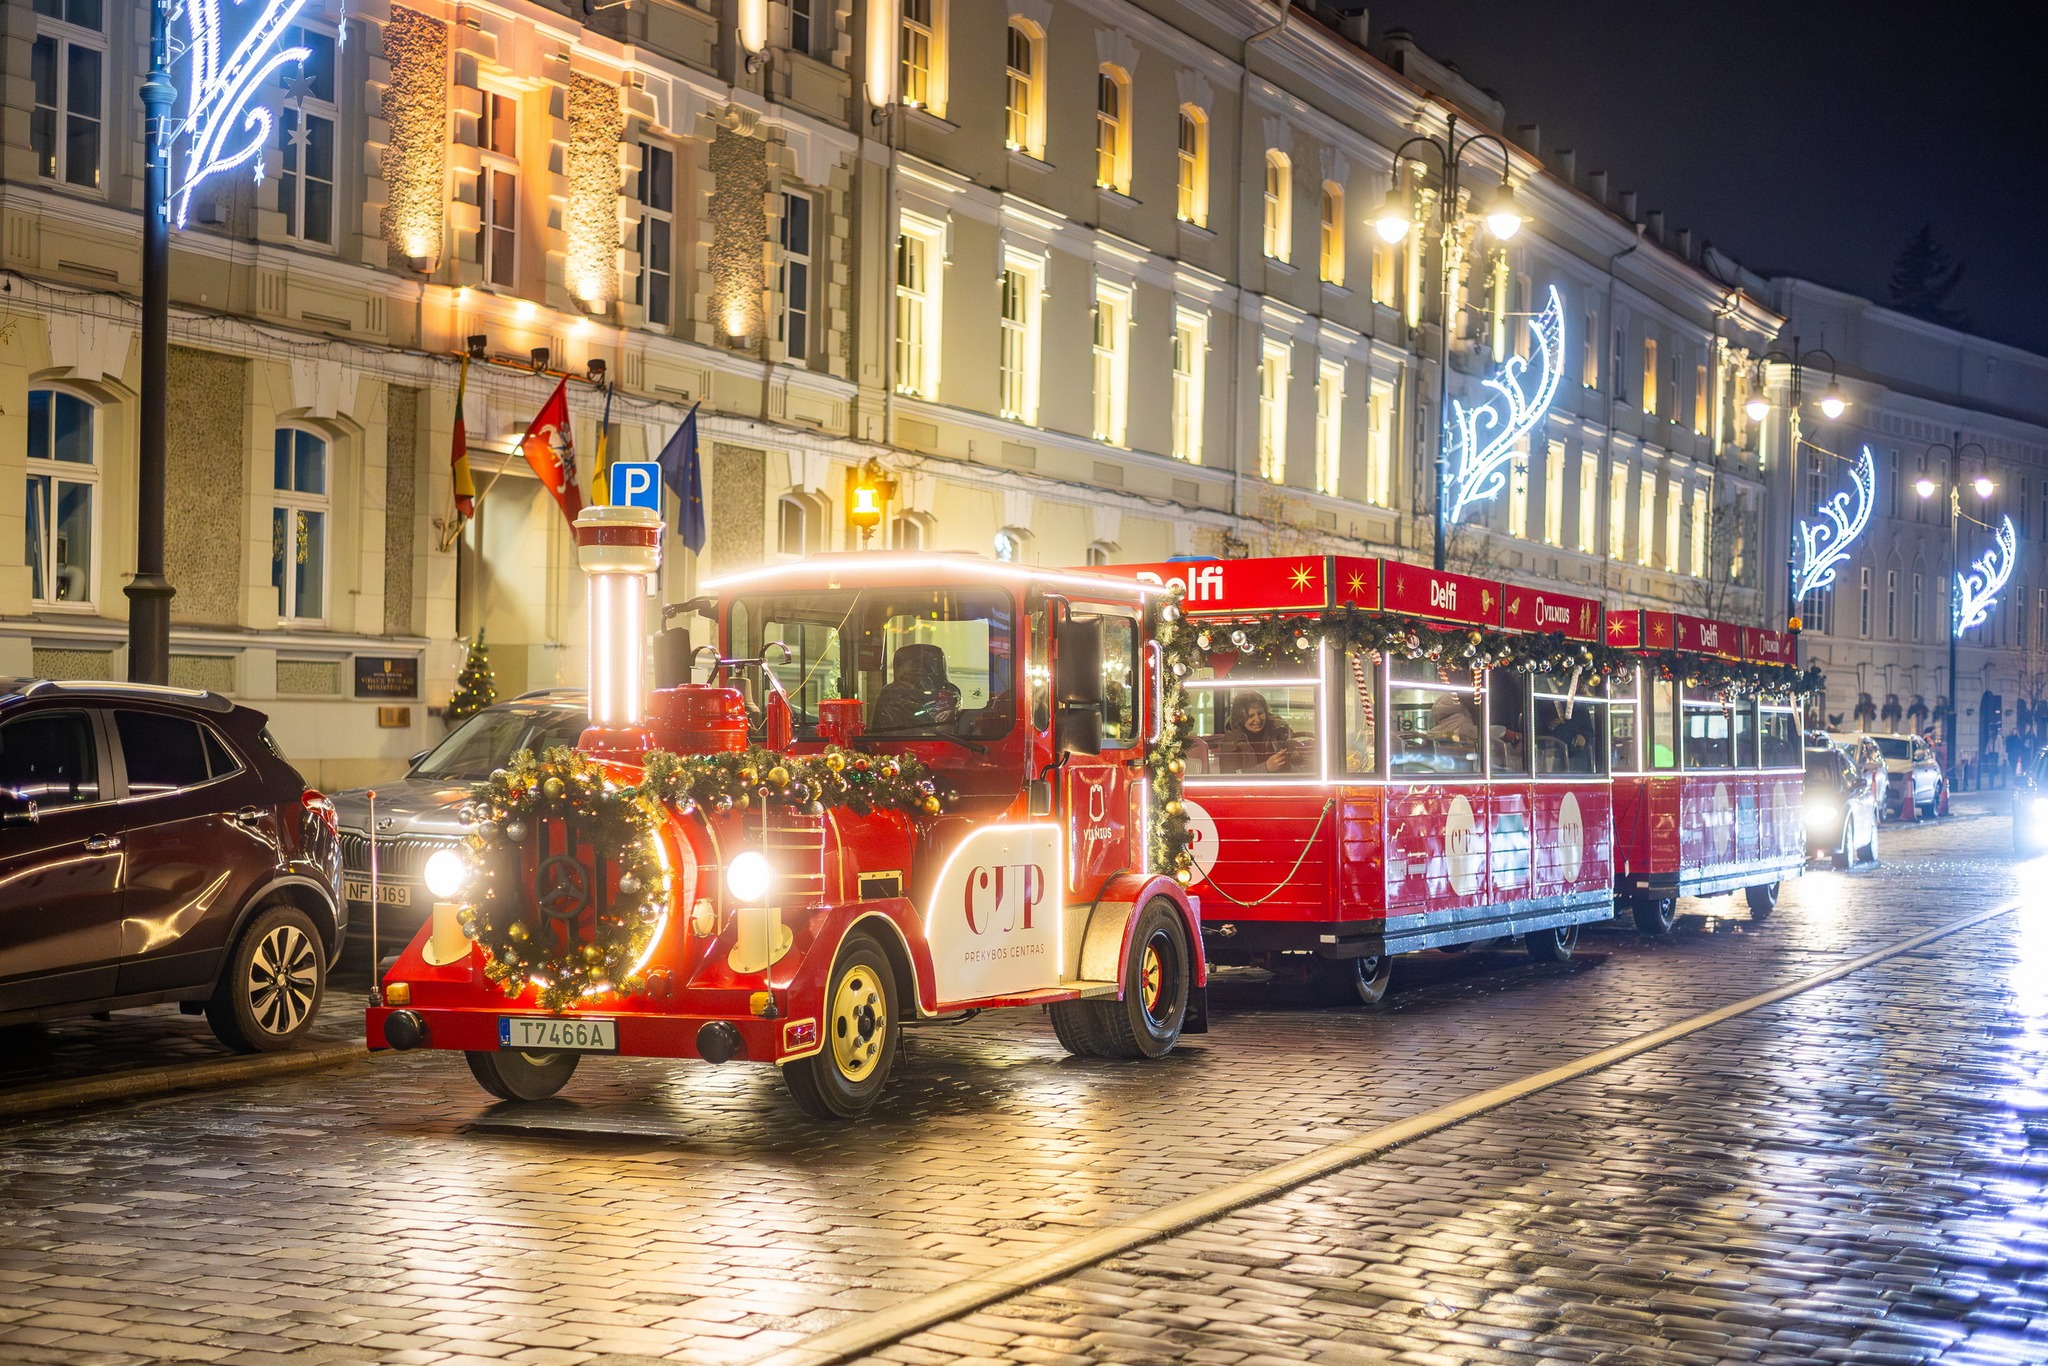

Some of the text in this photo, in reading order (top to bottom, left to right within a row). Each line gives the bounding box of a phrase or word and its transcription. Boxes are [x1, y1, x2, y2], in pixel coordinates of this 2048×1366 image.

[625, 468, 651, 506] P
[1430, 579, 1457, 611] Delfi
[1544, 604, 1570, 624] VILNIUS
[1700, 623, 1718, 648] Delfi
[1083, 827, 1112, 841] VILNIUS
[1451, 828, 1472, 855] CUP
[1563, 822, 1579, 845] CUP
[964, 863, 1045, 936] CUP
[965, 943, 1045, 963] PREKYBOS CENTRAS
[520, 1022, 604, 1047] T7466A
